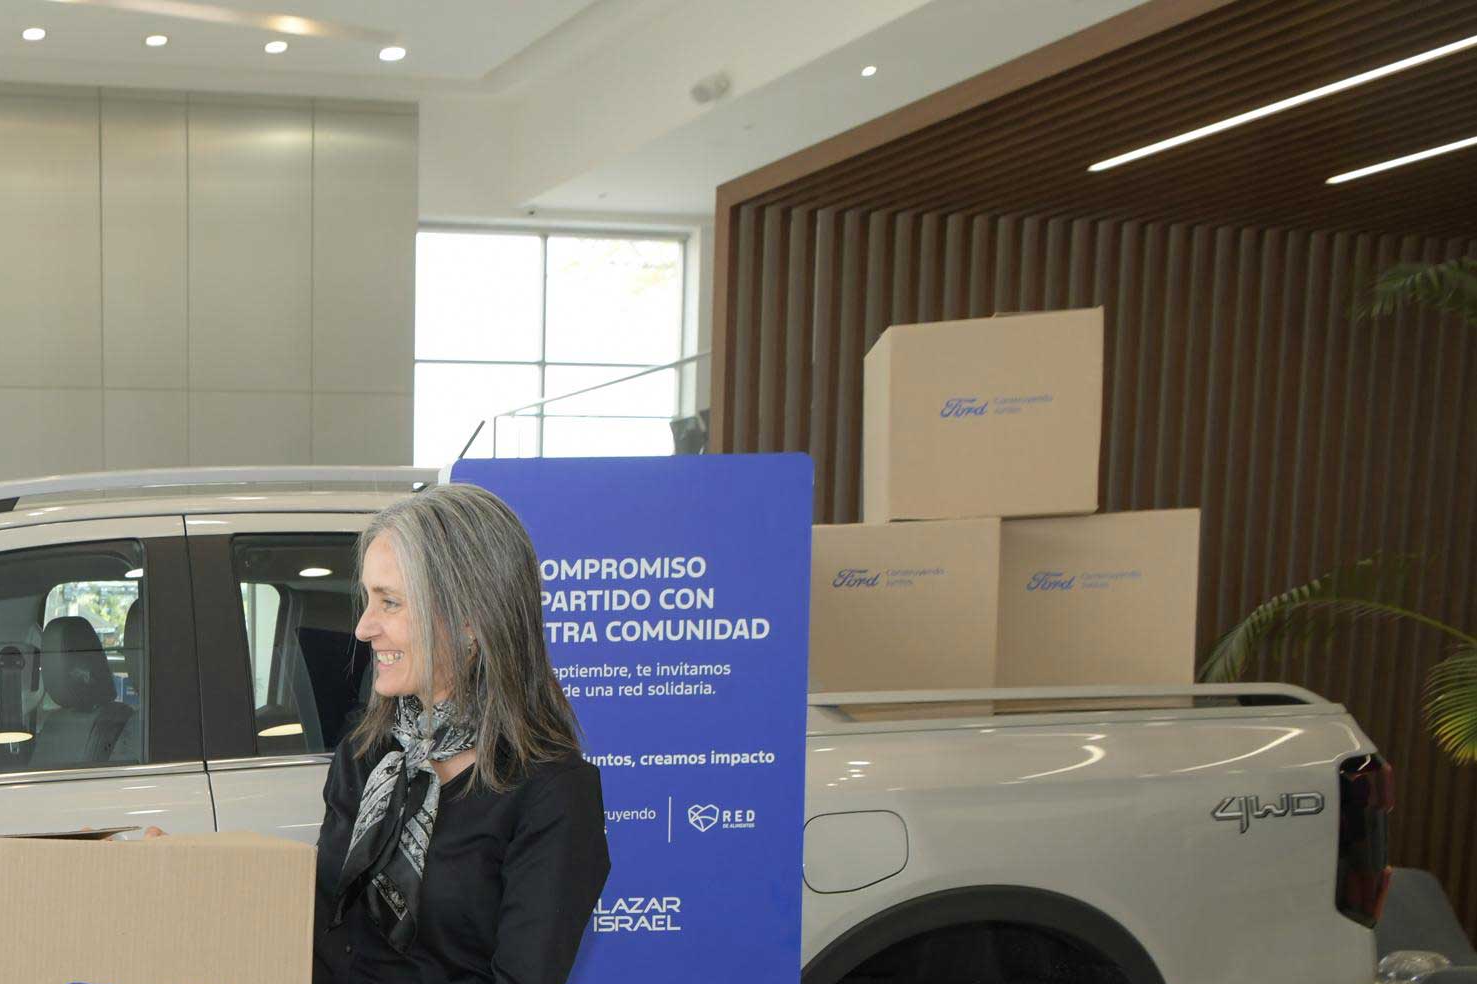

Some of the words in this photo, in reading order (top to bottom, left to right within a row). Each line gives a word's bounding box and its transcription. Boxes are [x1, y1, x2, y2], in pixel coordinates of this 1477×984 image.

[940, 398, 988, 418] Ford
[540, 556, 706, 580] OMPROMISO
[832, 568, 881, 588] Ford
[1026, 571, 1075, 591] Ford
[540, 589, 651, 612] PARTIDO
[659, 588, 714, 610] CON
[543, 621, 598, 643] TRA
[605, 618, 771, 642] COMUNIDAD
[552, 663, 632, 680] eptiembre,
[636, 664, 652, 677] te
[656, 662, 732, 677] invitamos
[562, 684, 580, 697] de
[585, 685, 614, 697] una
[618, 683, 643, 697] red
[647, 681, 716, 696] solidaria.
[640, 753, 706, 766] creamos
[710, 750, 775, 766] impacto
[604, 808, 656, 822] ruyendo
[1211, 791, 1324, 834] 4WD
[593, 915, 681, 932] ISRAEL
